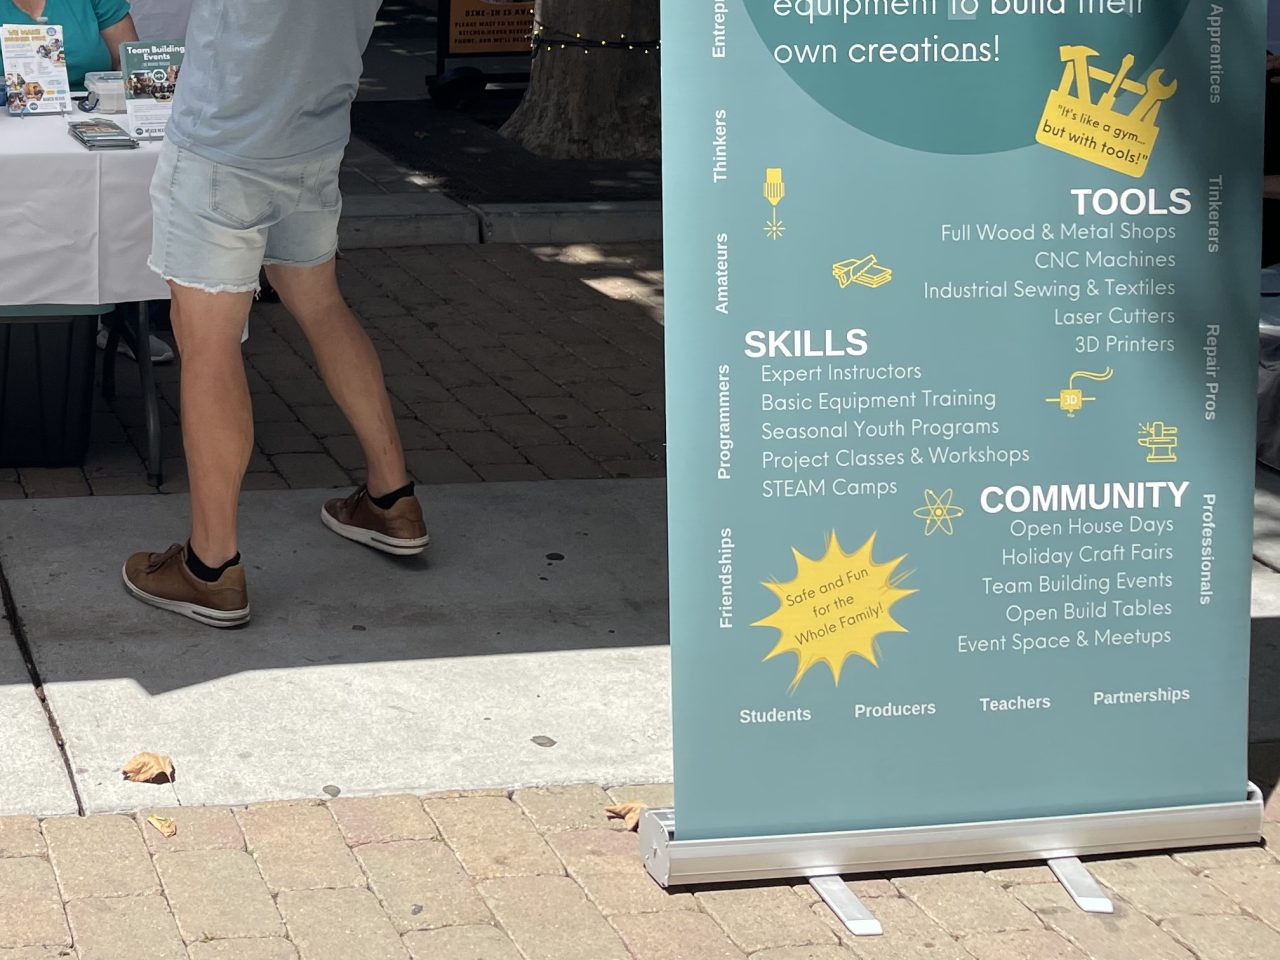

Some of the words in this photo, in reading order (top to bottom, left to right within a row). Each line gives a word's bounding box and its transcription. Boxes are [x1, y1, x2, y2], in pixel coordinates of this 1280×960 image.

[775, 45, 836, 64] own
[849, 35, 999, 62] creations!
[1207, 4, 1223, 103] Apprentices
[1058, 105, 1077, 121] "It's
[1080, 113, 1099, 128] like
[1103, 124, 1110, 132] a
[1114, 128, 1146, 145] gym...
[713, 110, 726, 183] Thinkers
[1043, 120, 1065, 136] but
[1069, 130, 1096, 150] with
[1101, 142, 1148, 165] tools!"
[1071, 188, 1191, 215] TOOLS
[1208, 175, 1222, 252] Tinkerers
[942, 224, 970, 241] Full
[977, 224, 1034, 240] Wood
[1042, 224, 1054, 240] &
[1061, 223, 1113, 239] Metal
[1120, 223, 1175, 243] Shops
[1035, 251, 1079, 268] CNC
[1086, 251, 1175, 267] Machines
[716, 233, 728, 314] Amateurs
[925, 281, 1006, 298] Industrial
[1014, 280, 1080, 301] Sewing
[1087, 279, 1099, 295] &
[1104, 279, 1175, 295] Textiles
[1055, 309, 1102, 325] Laser
[1109, 307, 1174, 323] Cutters
[745, 329, 867, 357] SKILLS
[1076, 336, 1099, 352] 3D
[1107, 336, 1174, 352] Printers
[1203, 325, 1219, 377] Repair
[762, 365, 822, 386] Expert
[829, 364, 921, 380] Instructors
[762, 393, 812, 410] Basic
[819, 392, 916, 414] Equipment
[922, 389, 995, 410] Training
[1064, 395, 1077, 405] 3D
[1205, 383, 1218, 420] Pros
[718, 365, 733, 479] Programmers
[762, 421, 847, 439] Seasonal
[854, 420, 904, 437] Youth
[912, 419, 999, 439] Programs
[763, 451, 829, 472] Project
[836, 450, 904, 466] Classes
[911, 448, 923, 464] &
[929, 446, 1029, 466] Workshops
[763, 479, 824, 497] STEAM
[833, 479, 897, 499] Camps
[981, 481, 1189, 513] COMMUNITY
[1011, 520, 1061, 540] Open
[1069, 518, 1123, 534] House
[1130, 516, 1173, 536] Days
[1003, 548, 1073, 568] Holiday
[1079, 544, 1125, 562] Craft
[1132, 544, 1173, 560] Fairs
[1200, 494, 1216, 604] Professionals
[718, 528, 734, 627] Friendships
[786, 588, 816, 606] Safe
[819, 576, 844, 594] and
[846, 568, 868, 584] Fun
[982, 578, 1032, 594] Team
[1040, 575, 1109, 594] Building
[1117, 572, 1172, 588] Events
[813, 603, 832, 618] for
[834, 595, 854, 609] the
[1006, 605, 1057, 626] Open
[1065, 601, 1106, 619] Build
[1112, 599, 1171, 616] Tables
[794, 622, 837, 645] Whole
[839, 602, 884, 628] Family!
[959, 636, 1006, 652] Event
[1012, 633, 1070, 654] Space
[1077, 631, 1088, 646] &
[1095, 629, 1171, 647] Meetups
[980, 696, 1050, 711] Teachers
[1094, 687, 1190, 704] Partnerships
[740, 708, 811, 723] Students
[855, 703, 936, 717] Producers
